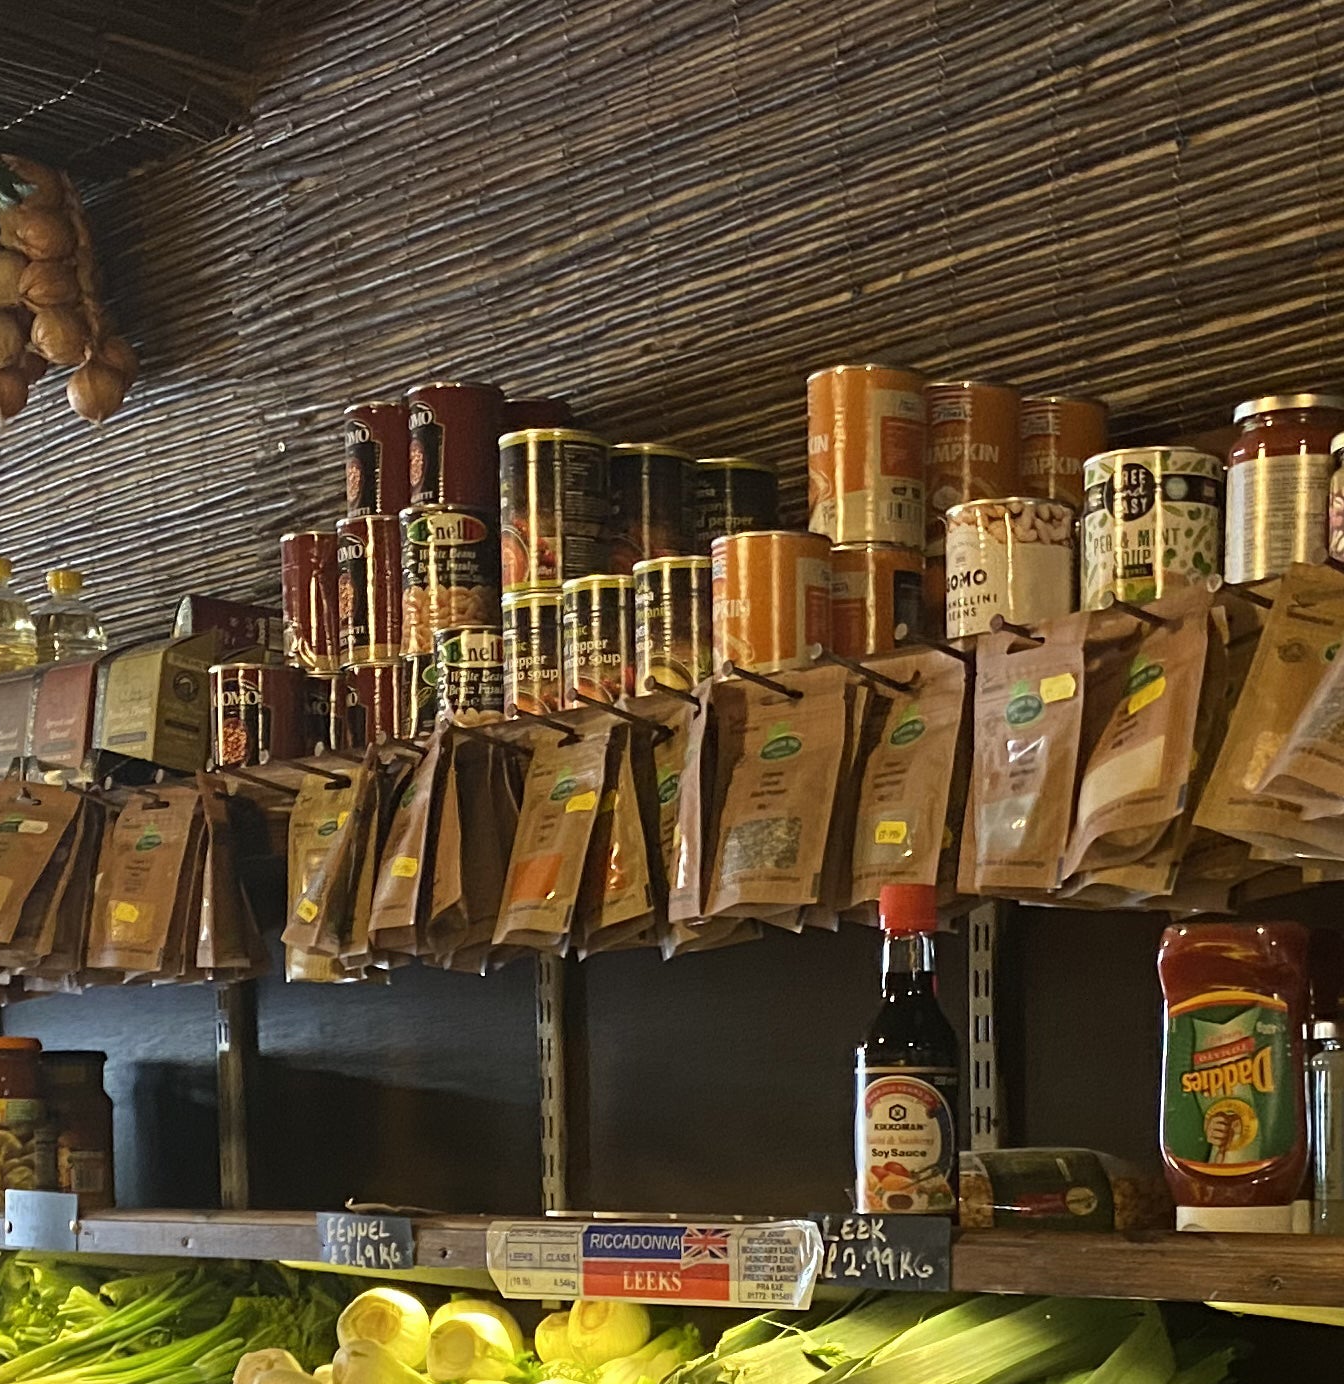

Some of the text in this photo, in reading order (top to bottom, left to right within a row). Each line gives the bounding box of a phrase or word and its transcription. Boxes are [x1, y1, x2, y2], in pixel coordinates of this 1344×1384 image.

[1182, 1046, 1275, 1097] Daddies
[874, 1123, 924, 1131] KIKKOMAN
[871, 1148, 927, 1160] Soy Sauce
[326, 1217, 390, 1243] FENNEL
[823, 1215, 887, 1243] LEEK
[589, 1233, 681, 1252] RICCADONNA
[623, 1270, 682, 1292] LEEKS
